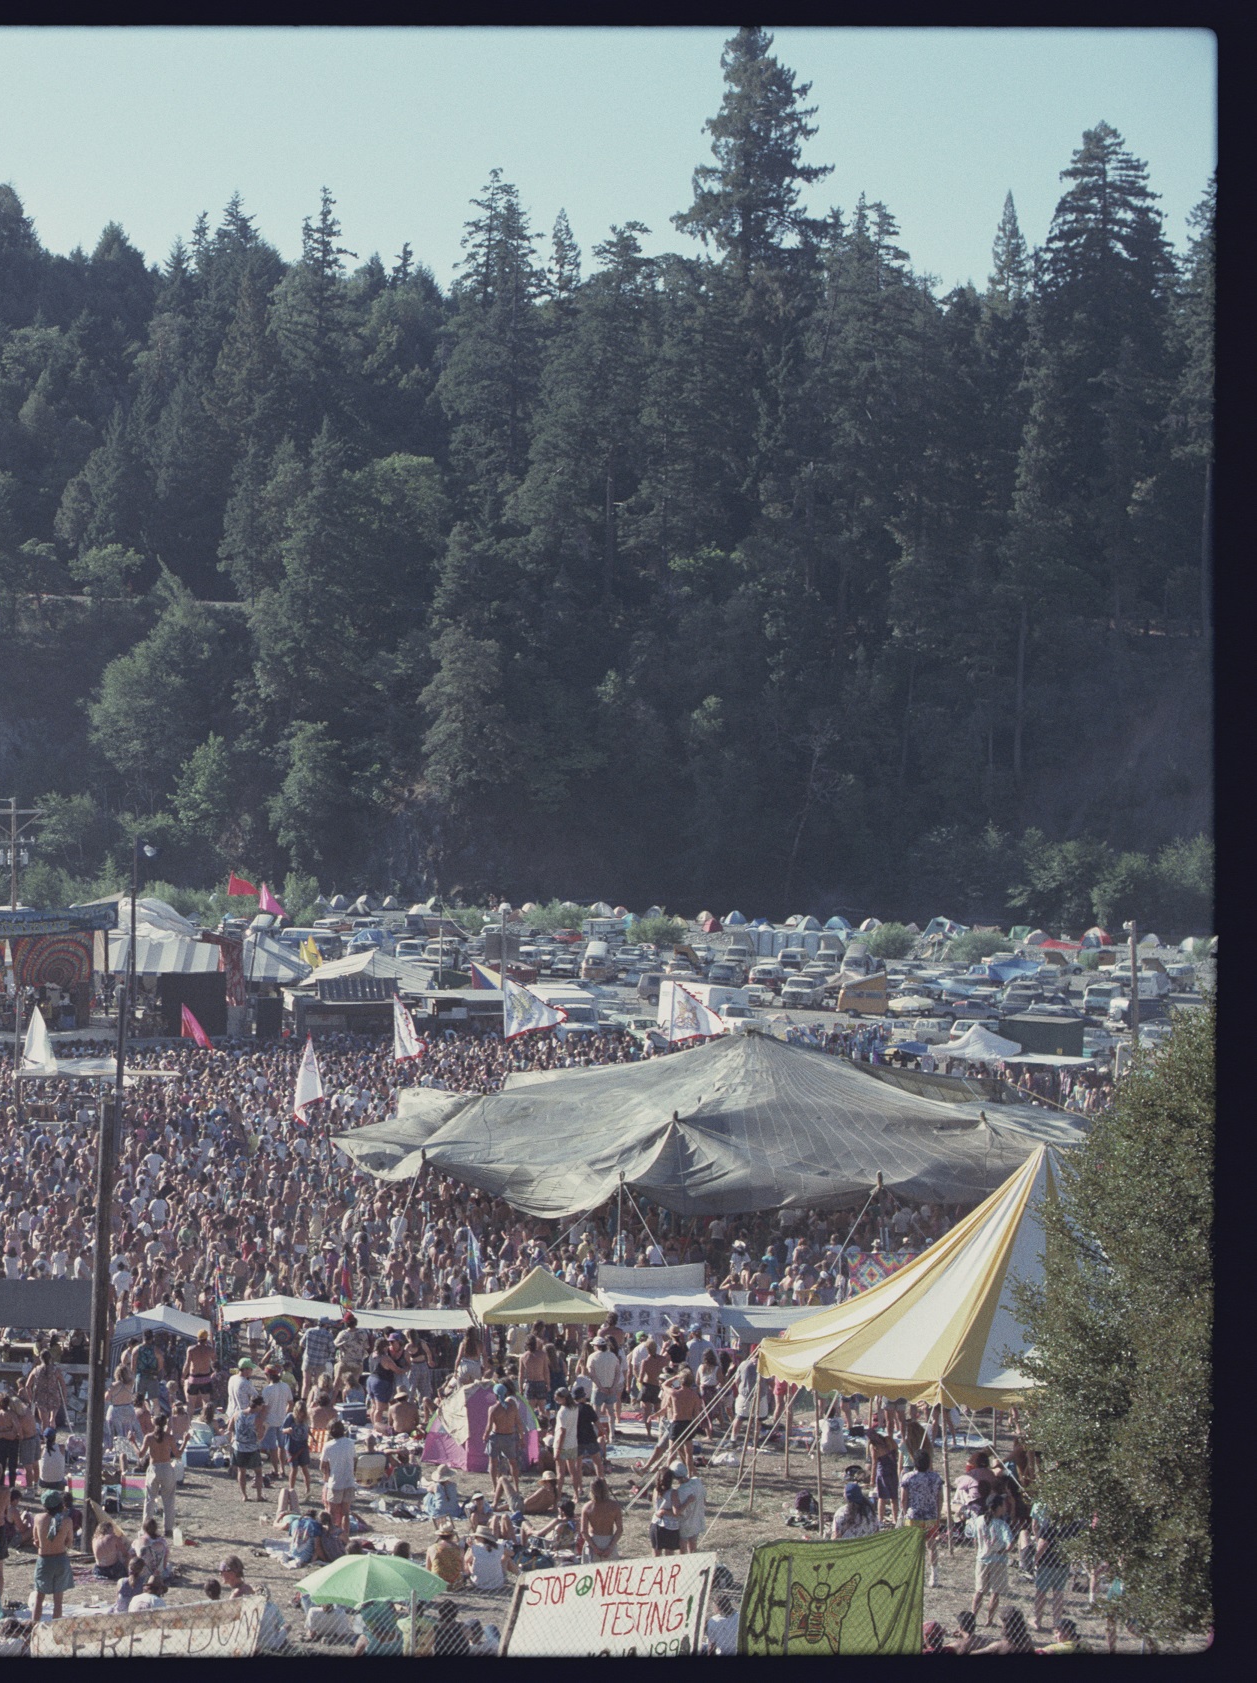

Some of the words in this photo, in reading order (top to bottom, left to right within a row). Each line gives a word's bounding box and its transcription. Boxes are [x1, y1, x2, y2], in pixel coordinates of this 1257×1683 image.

[527, 1572, 577, 1606] STOP
[592, 1563, 681, 1599] NUCLEAR
[600, 1594, 693, 1637] TESTING!
